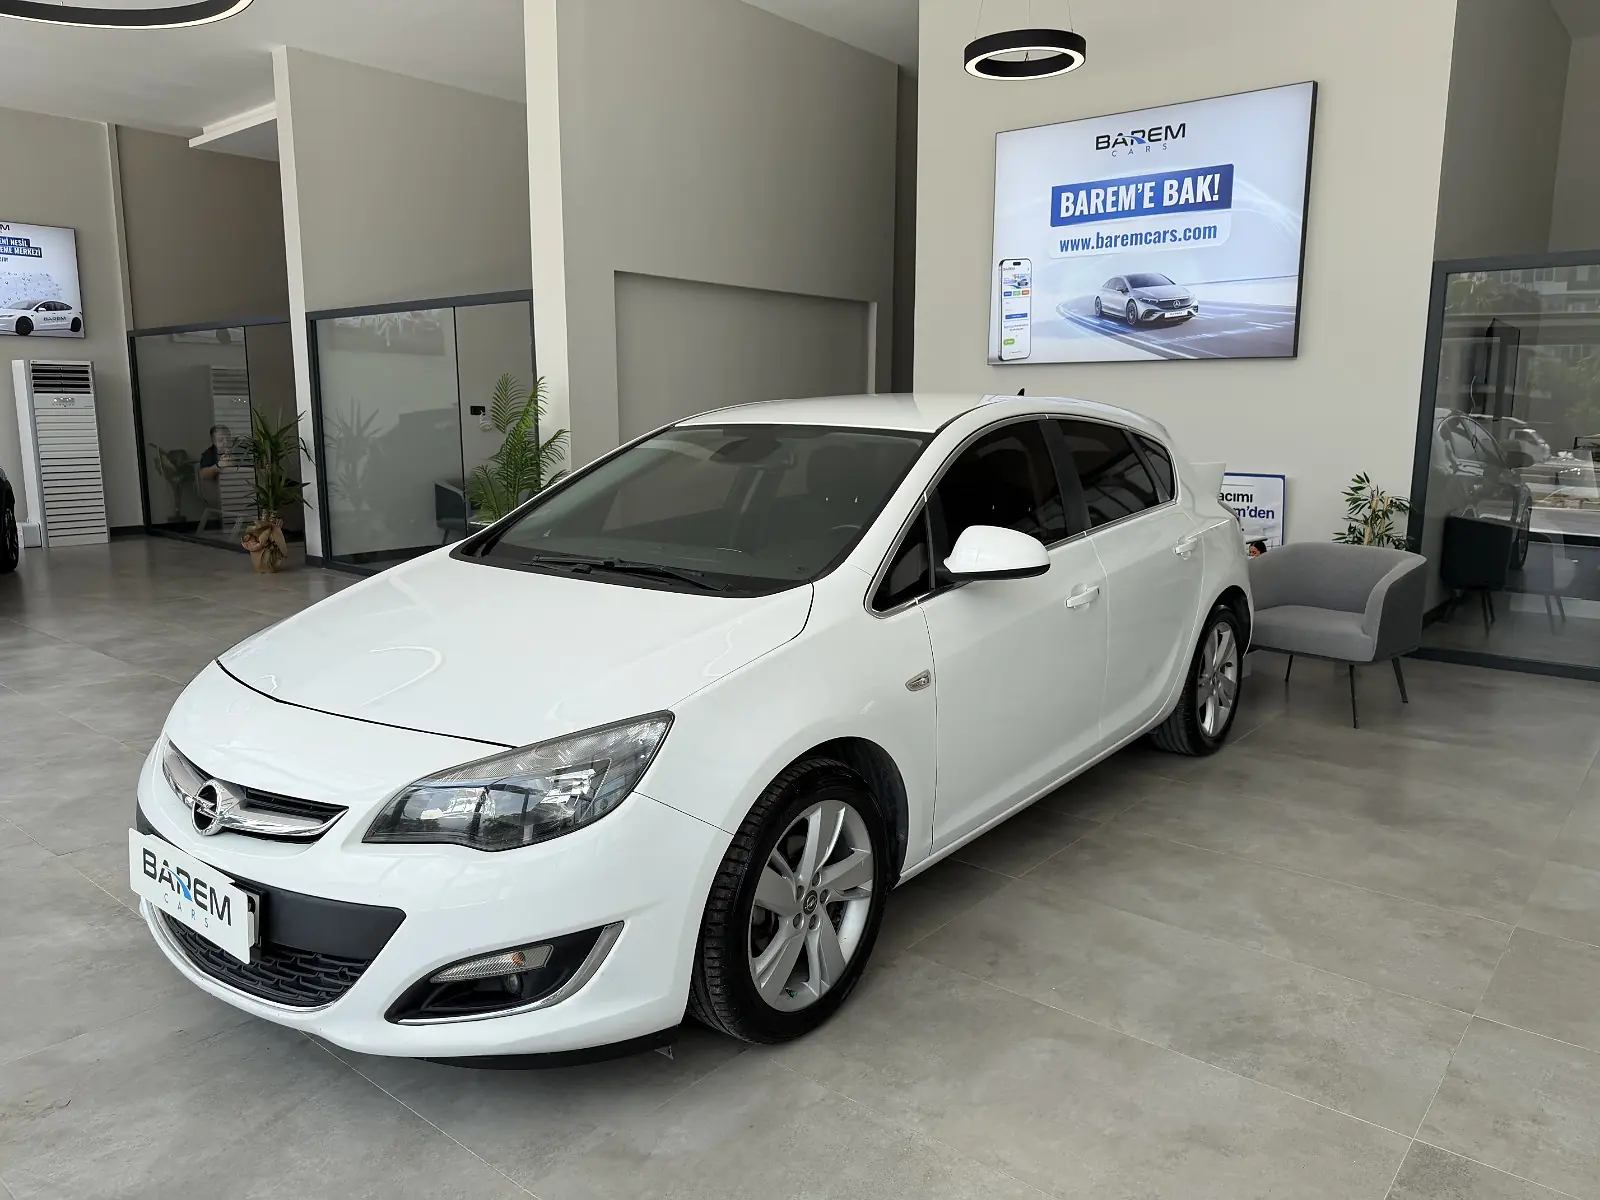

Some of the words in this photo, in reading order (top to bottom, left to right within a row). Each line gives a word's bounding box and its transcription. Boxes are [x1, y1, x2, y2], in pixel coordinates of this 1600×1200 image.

[1096, 123, 1186, 150] BAREM
[1111, 143, 1168, 157] CARS
[1162, 173, 1220, 206] BAK!
[1059, 224, 1218, 252] www.baremcars.com
[142, 847, 232, 927] BAREM
[163, 892, 209, 928] CARS
